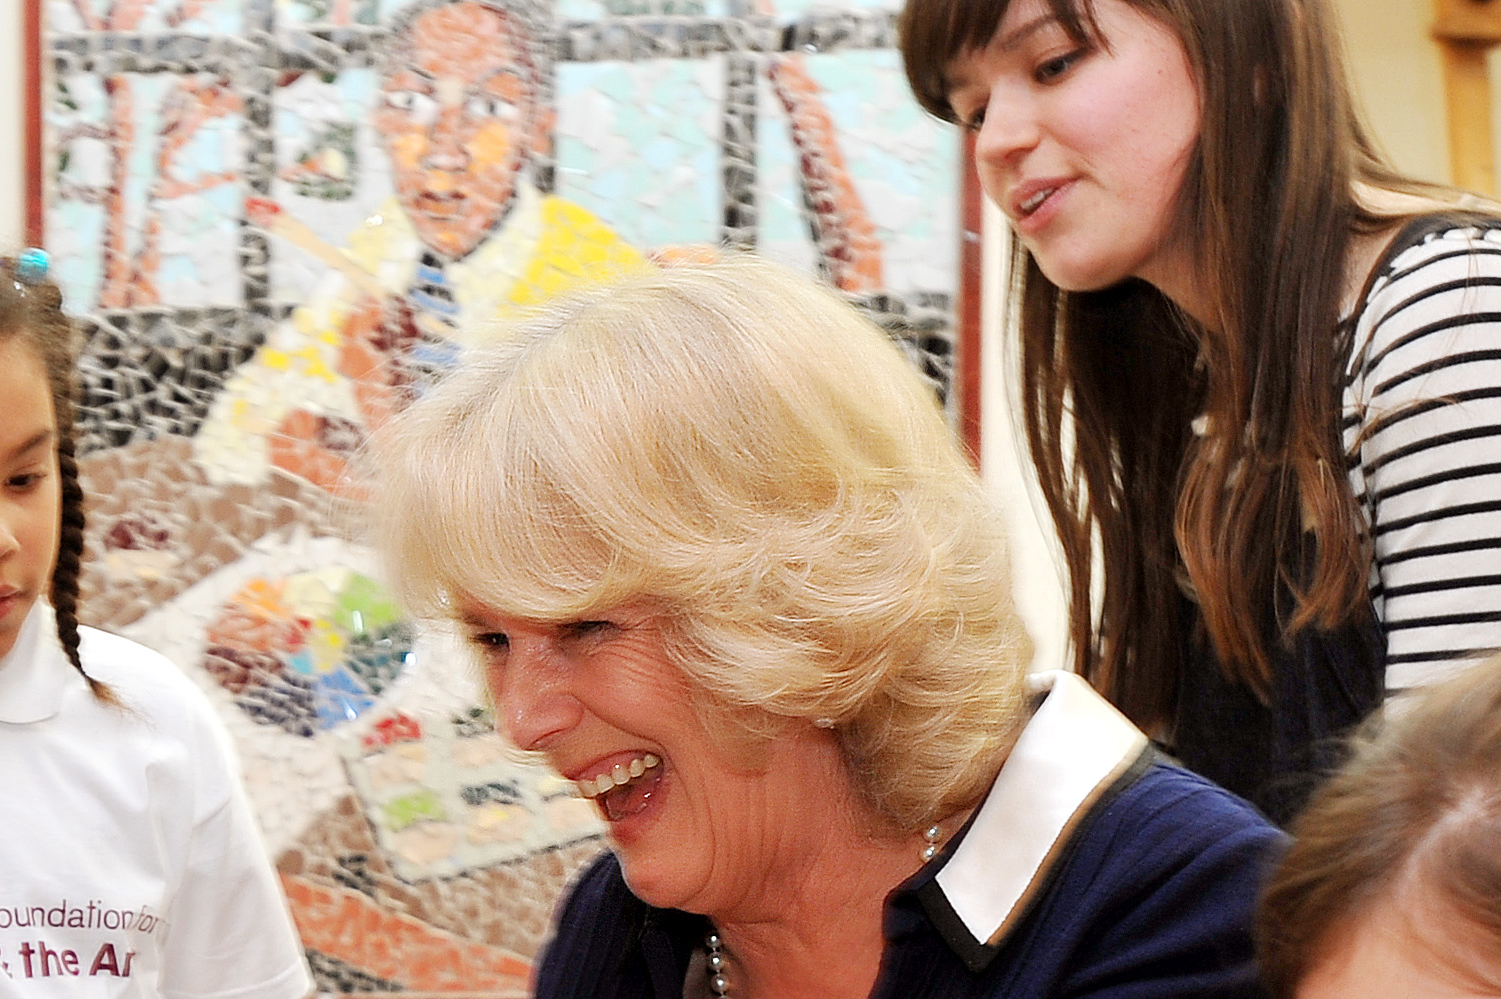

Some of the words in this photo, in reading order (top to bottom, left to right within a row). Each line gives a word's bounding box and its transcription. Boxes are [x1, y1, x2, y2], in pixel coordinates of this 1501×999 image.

[132, 904, 162, 934] for
[18, 941, 80, 978] the
[88, 942, 137, 978] Ar
